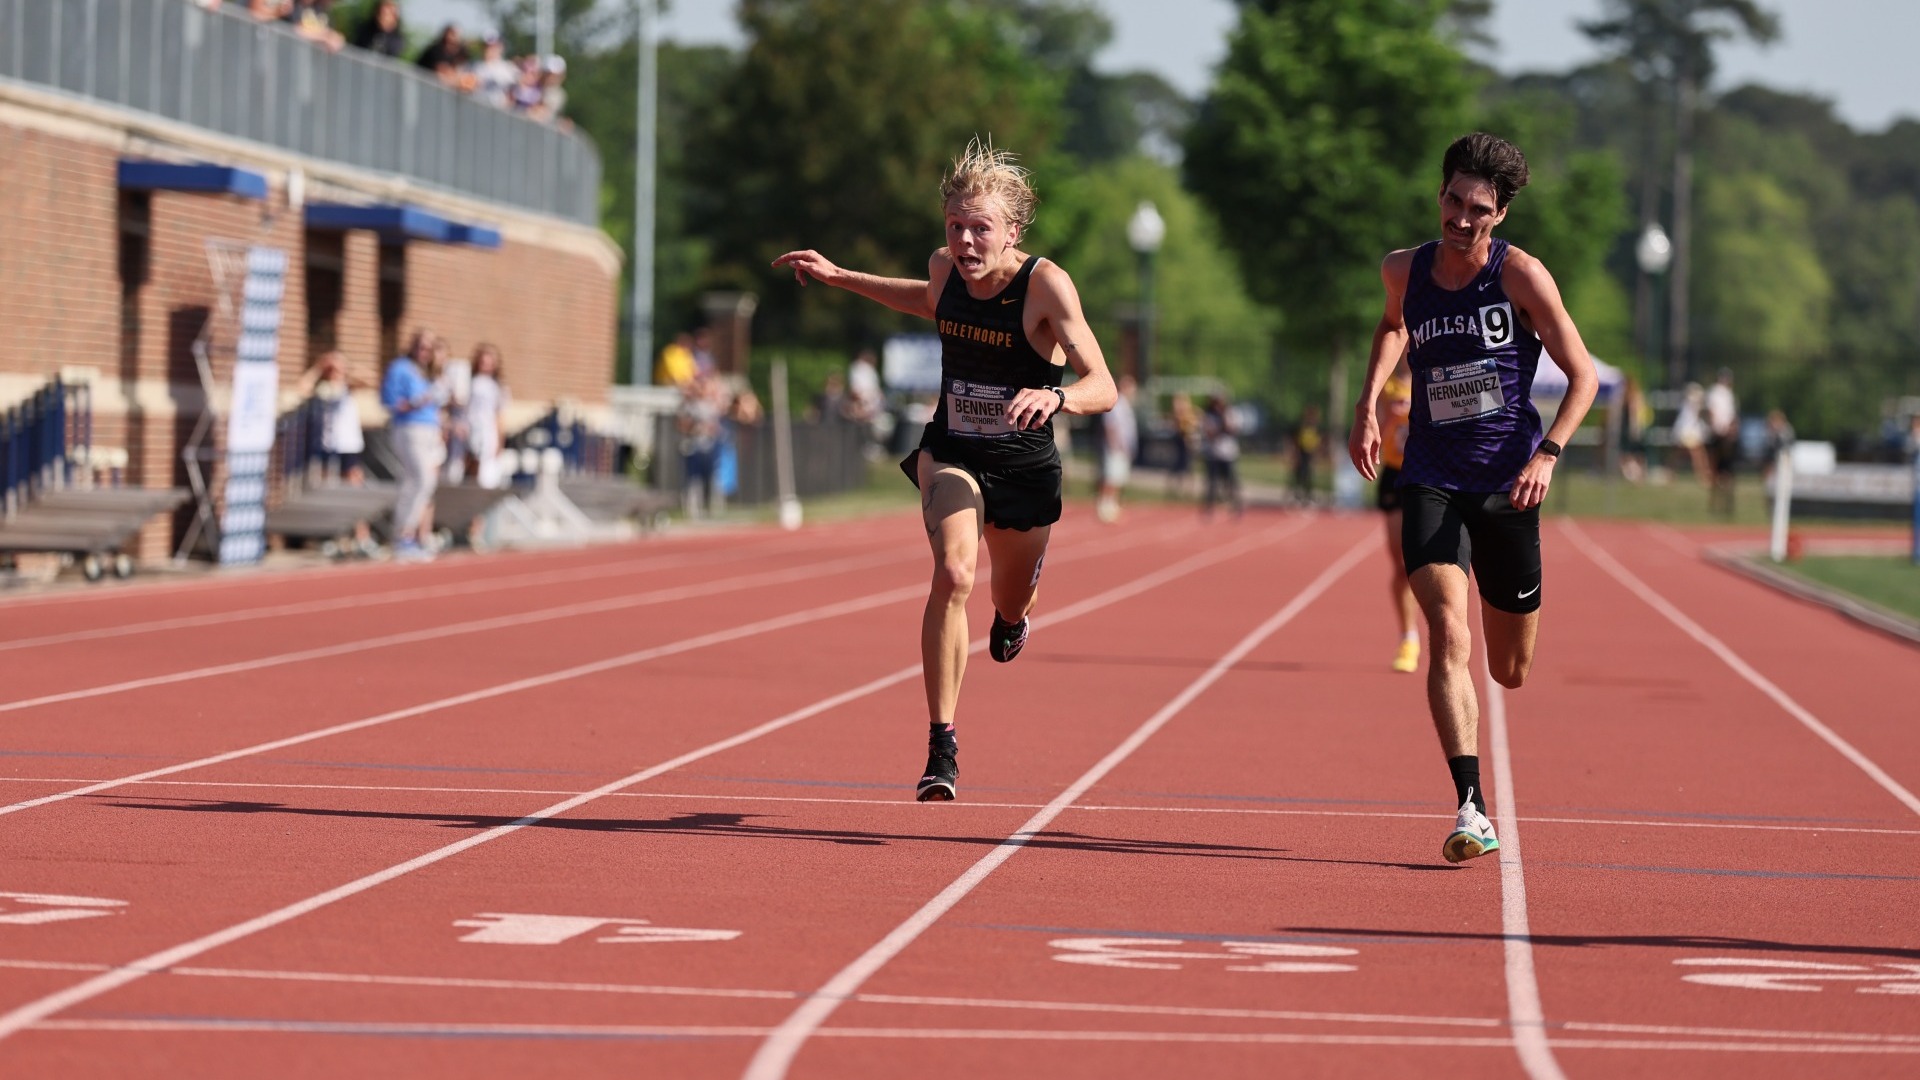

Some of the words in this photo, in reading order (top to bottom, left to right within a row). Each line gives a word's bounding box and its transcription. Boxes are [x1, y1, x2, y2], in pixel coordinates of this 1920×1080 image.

[940, 320, 1012, 348] OGLETHORPE
[1412, 315, 1482, 349] MILLSA
[1485, 307, 1510, 343] 9
[1453, 365, 1481, 374] CONFERENCE
[1465, 359, 1488, 368] OUTDOOR
[1429, 376, 1499, 402] HERNANDEZ
[955, 398, 1005, 417] BENNER
[961, 415, 999, 426] OGLETHORPE
[1047, 937, 1360, 973] 3
